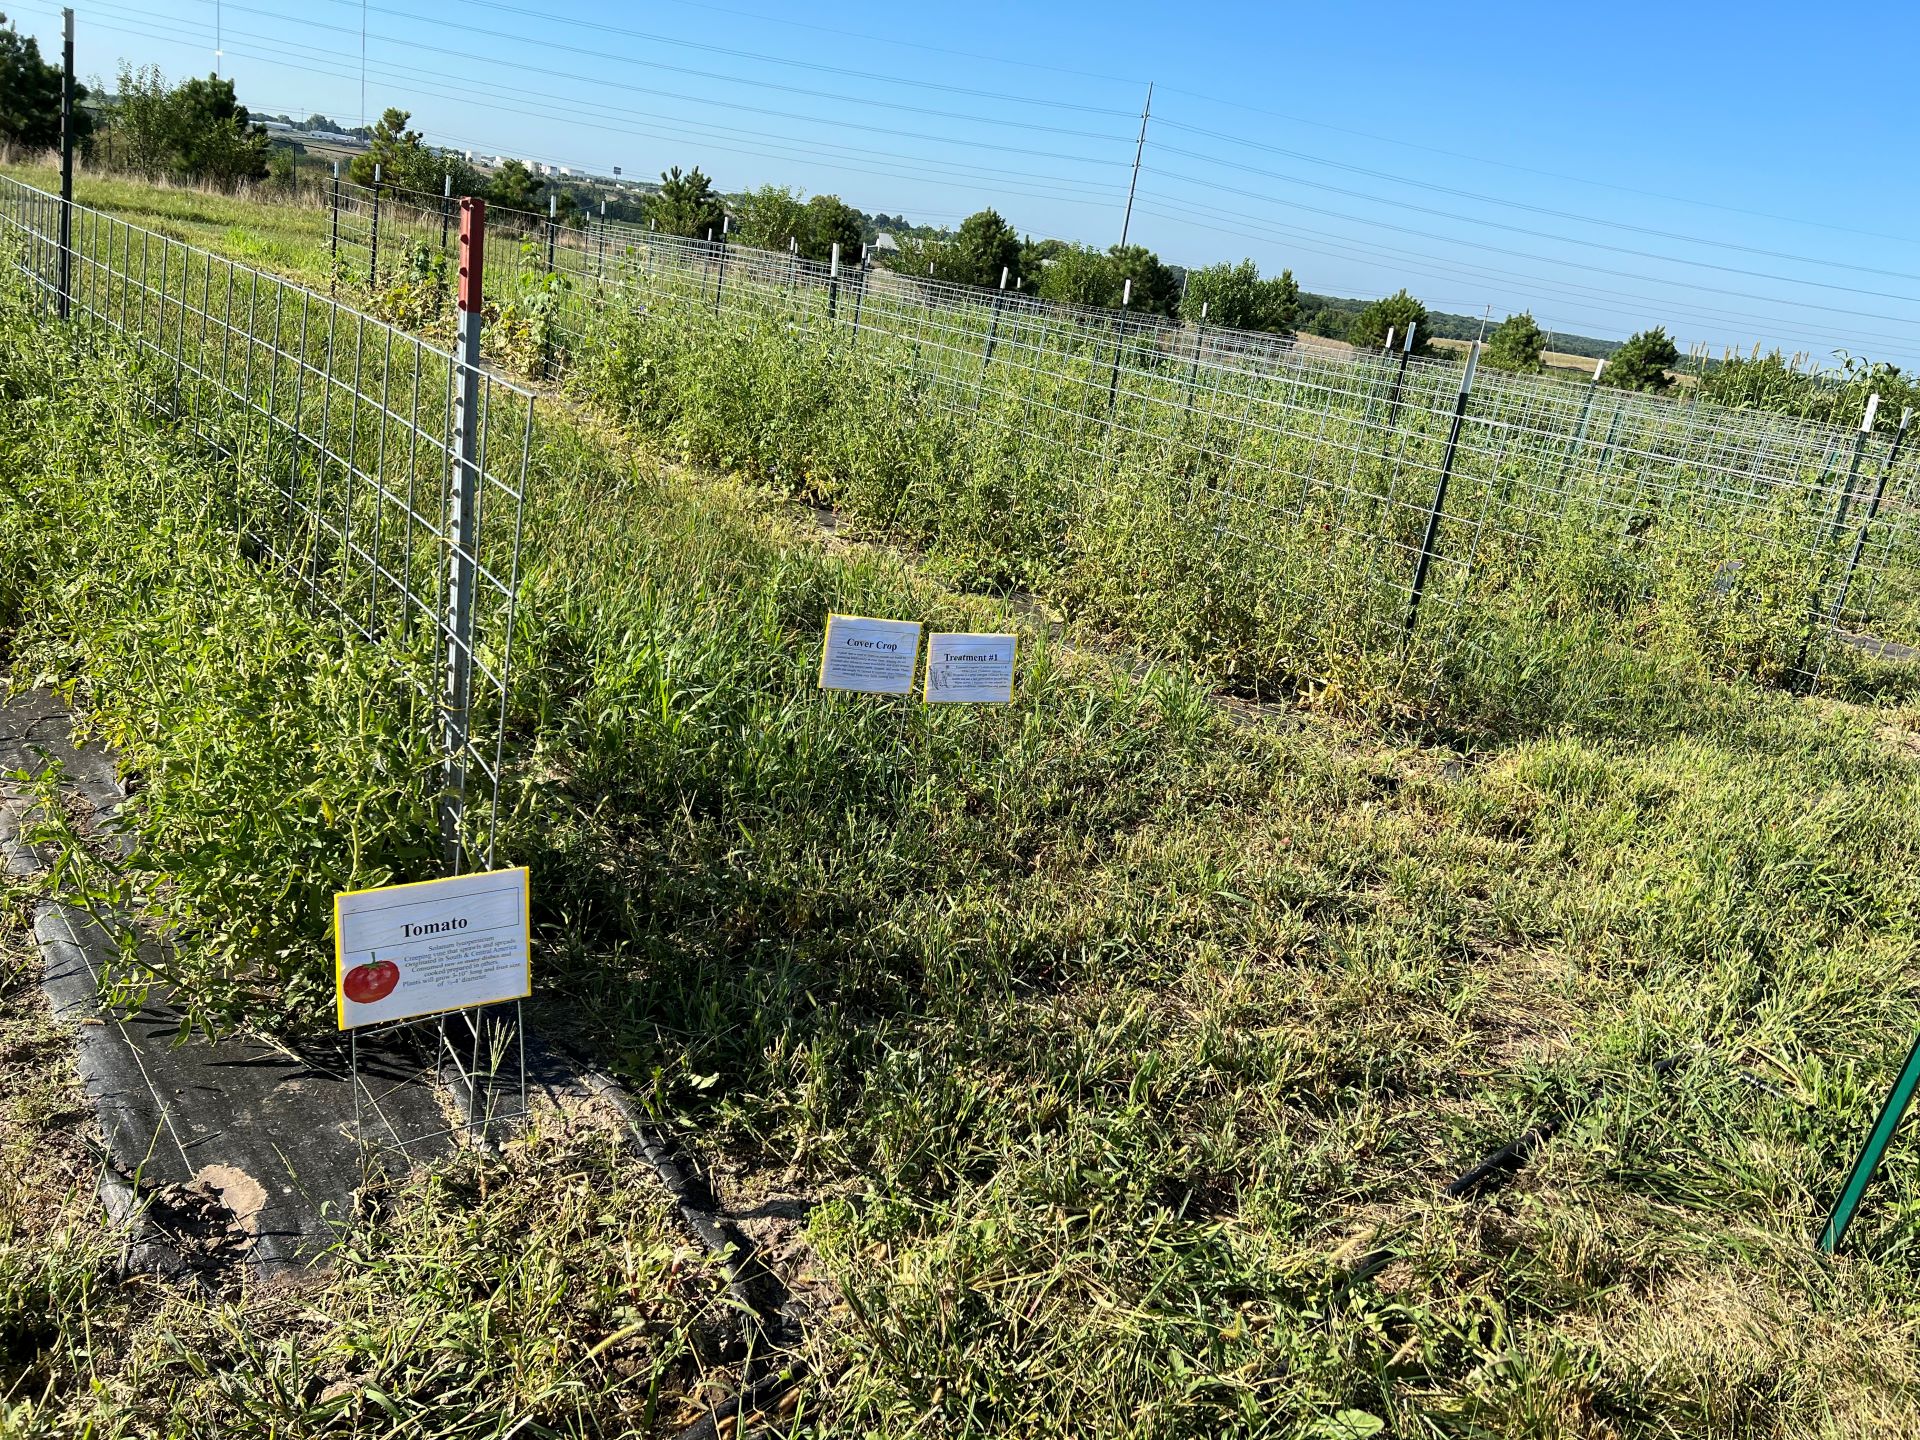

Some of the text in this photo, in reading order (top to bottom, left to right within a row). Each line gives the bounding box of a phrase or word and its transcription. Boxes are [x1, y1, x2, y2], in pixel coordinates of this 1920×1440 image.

[846, 638, 898, 652] Cover Crop
[944, 653, 998, 662] Treatment #1
[401, 917, 468, 938] Tomato
[404, 958, 437, 968] Originated
[470, 948, 492, 956] Central
[412, 963, 444, 972] Consumed
